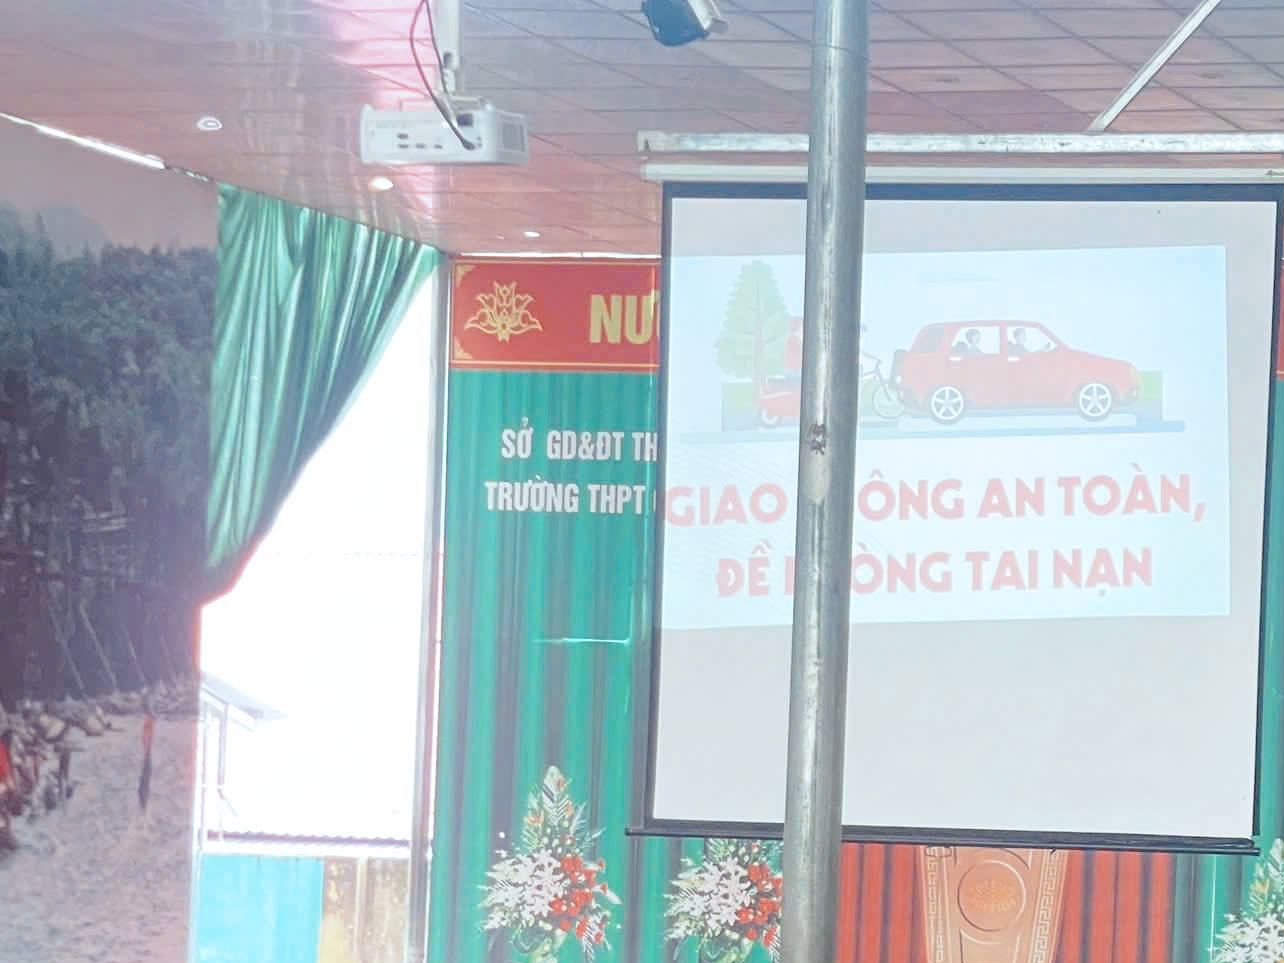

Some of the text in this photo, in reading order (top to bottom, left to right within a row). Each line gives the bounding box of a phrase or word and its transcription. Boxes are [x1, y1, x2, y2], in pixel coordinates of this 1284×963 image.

[589, 290, 660, 344] NƯ
[501, 416, 534, 460] SỞ
[546, 430, 625, 461] GD&ĐT
[485, 475, 580, 513] TRƯỜNG
[588, 484, 646, 515] THPT
[665, 483, 788, 527] GIAO
[857, 468, 965, 522] ÔNG
[977, 477, 1045, 519] AN
[1056, 462, 1207, 523] TOÀN,
[716, 539, 773, 598] ĐỀ
[964, 549, 1039, 591] TAI
[1053, 547, 1153, 597] NẠN
